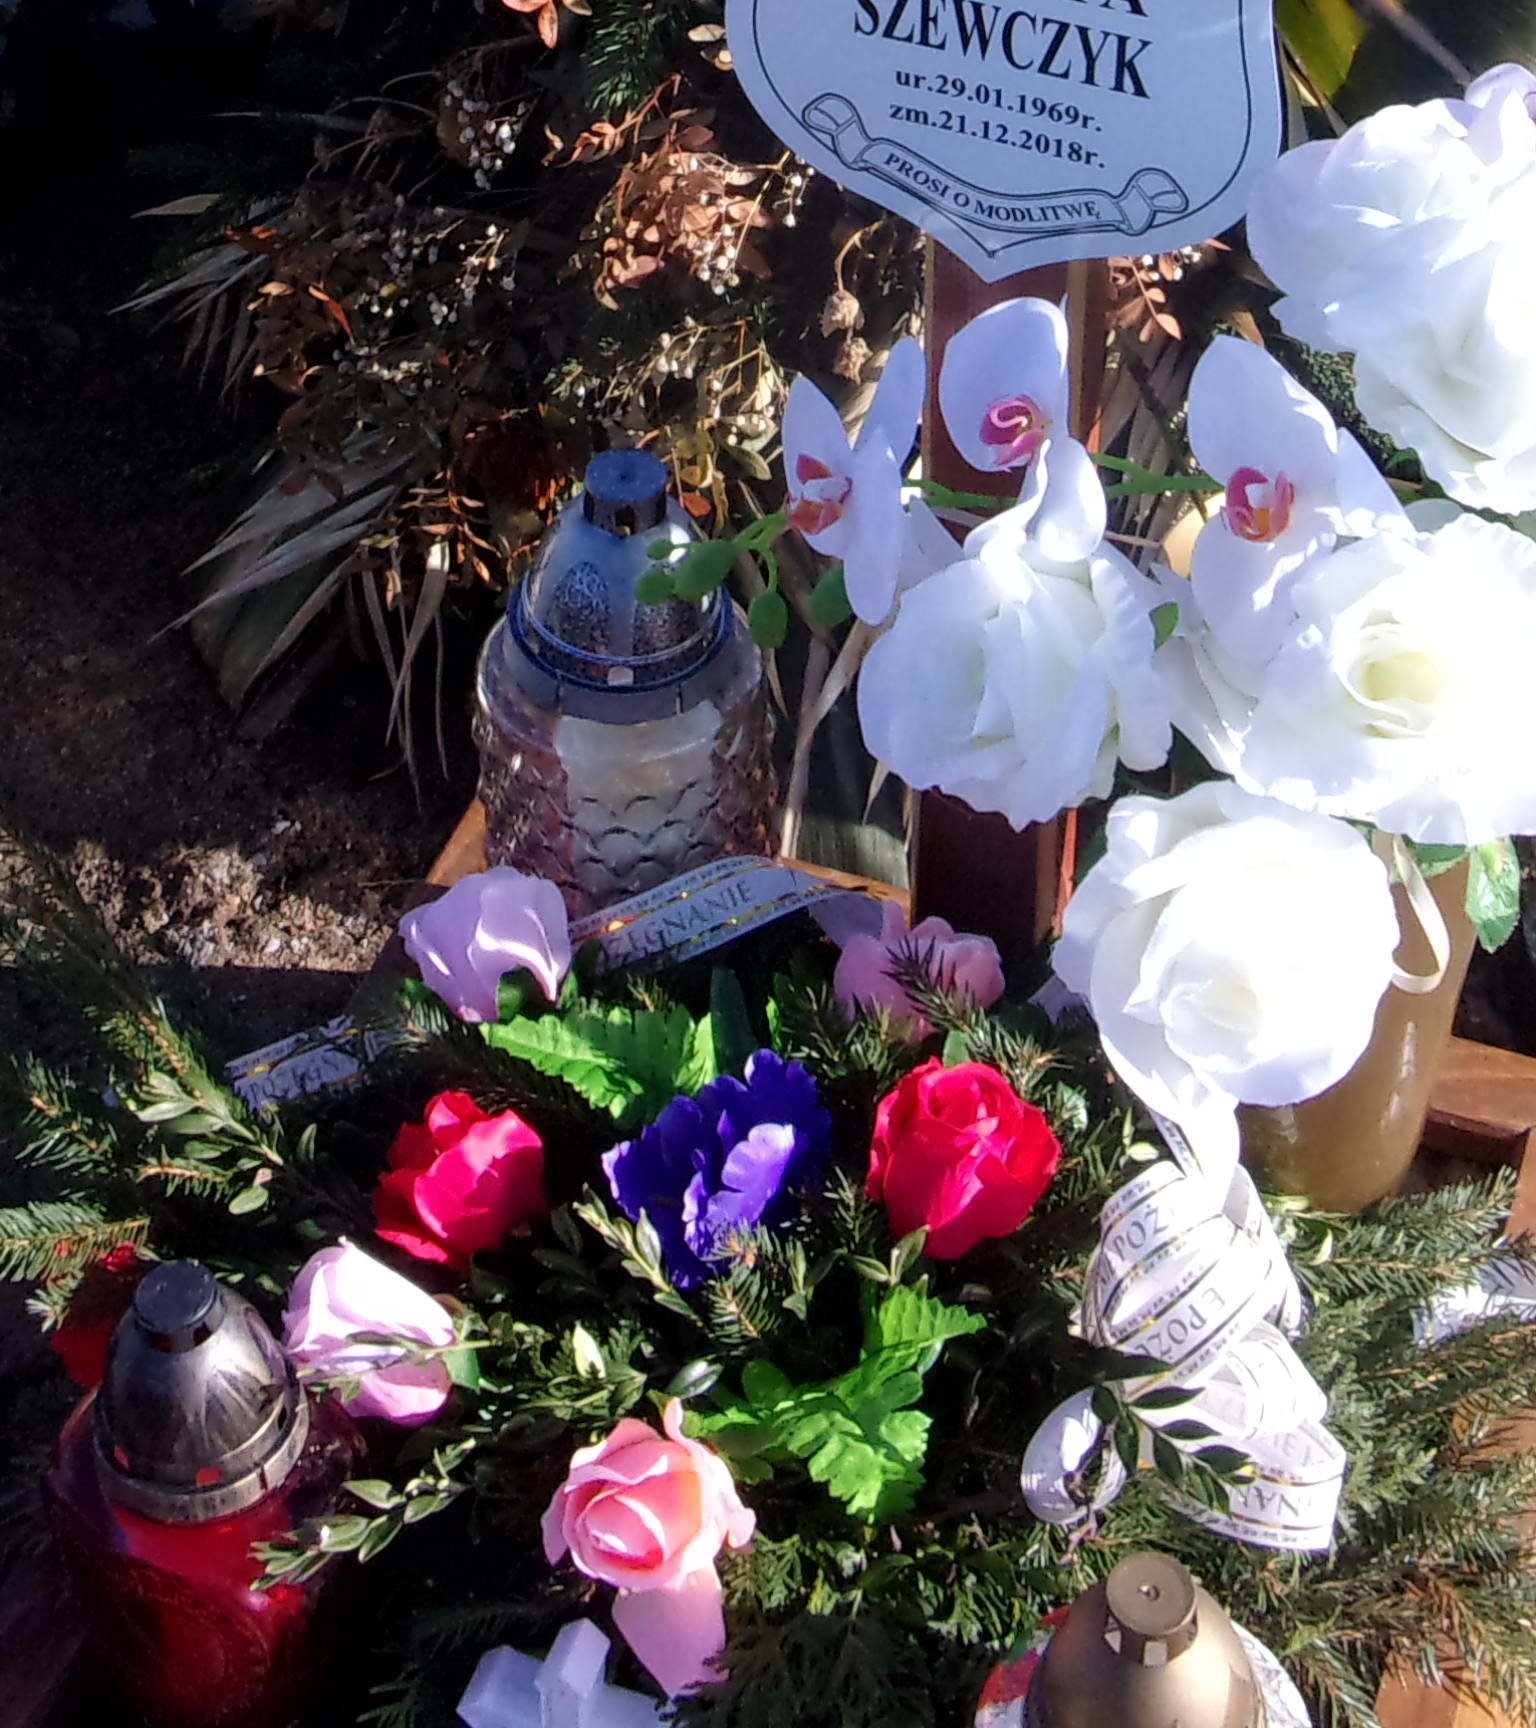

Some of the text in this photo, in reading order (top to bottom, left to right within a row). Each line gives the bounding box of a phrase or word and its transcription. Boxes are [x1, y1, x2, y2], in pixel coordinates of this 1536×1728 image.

[895, 70, 1103, 133] ur.29.01.1969r.
[889, 105, 1106, 169] zm.21.12.2018r.
[884, 151, 1102, 224] PROSI O MODLITWĘ
